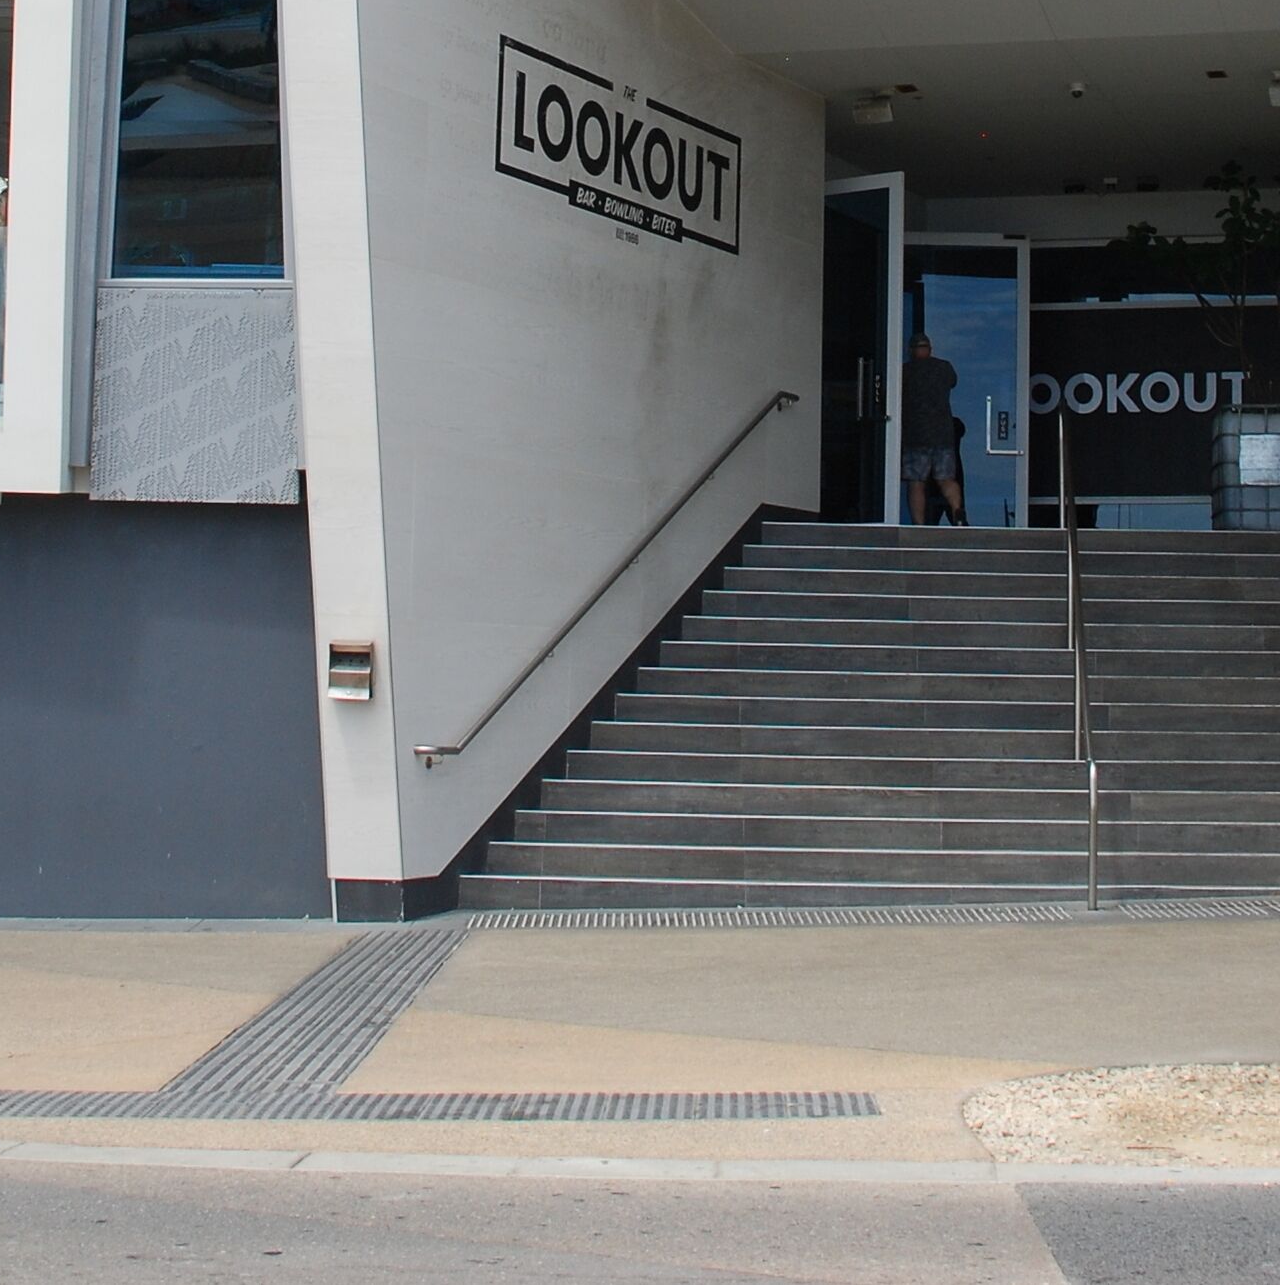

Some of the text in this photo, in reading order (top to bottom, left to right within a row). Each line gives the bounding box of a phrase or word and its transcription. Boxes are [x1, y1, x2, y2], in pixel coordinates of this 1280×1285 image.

[623, 85, 638, 102] THE
[513, 70, 730, 222] LOOKOUT
[576, 187, 677, 236] BAR BOWLING BITES
[1030, 371, 1245, 415] OOKOUT
